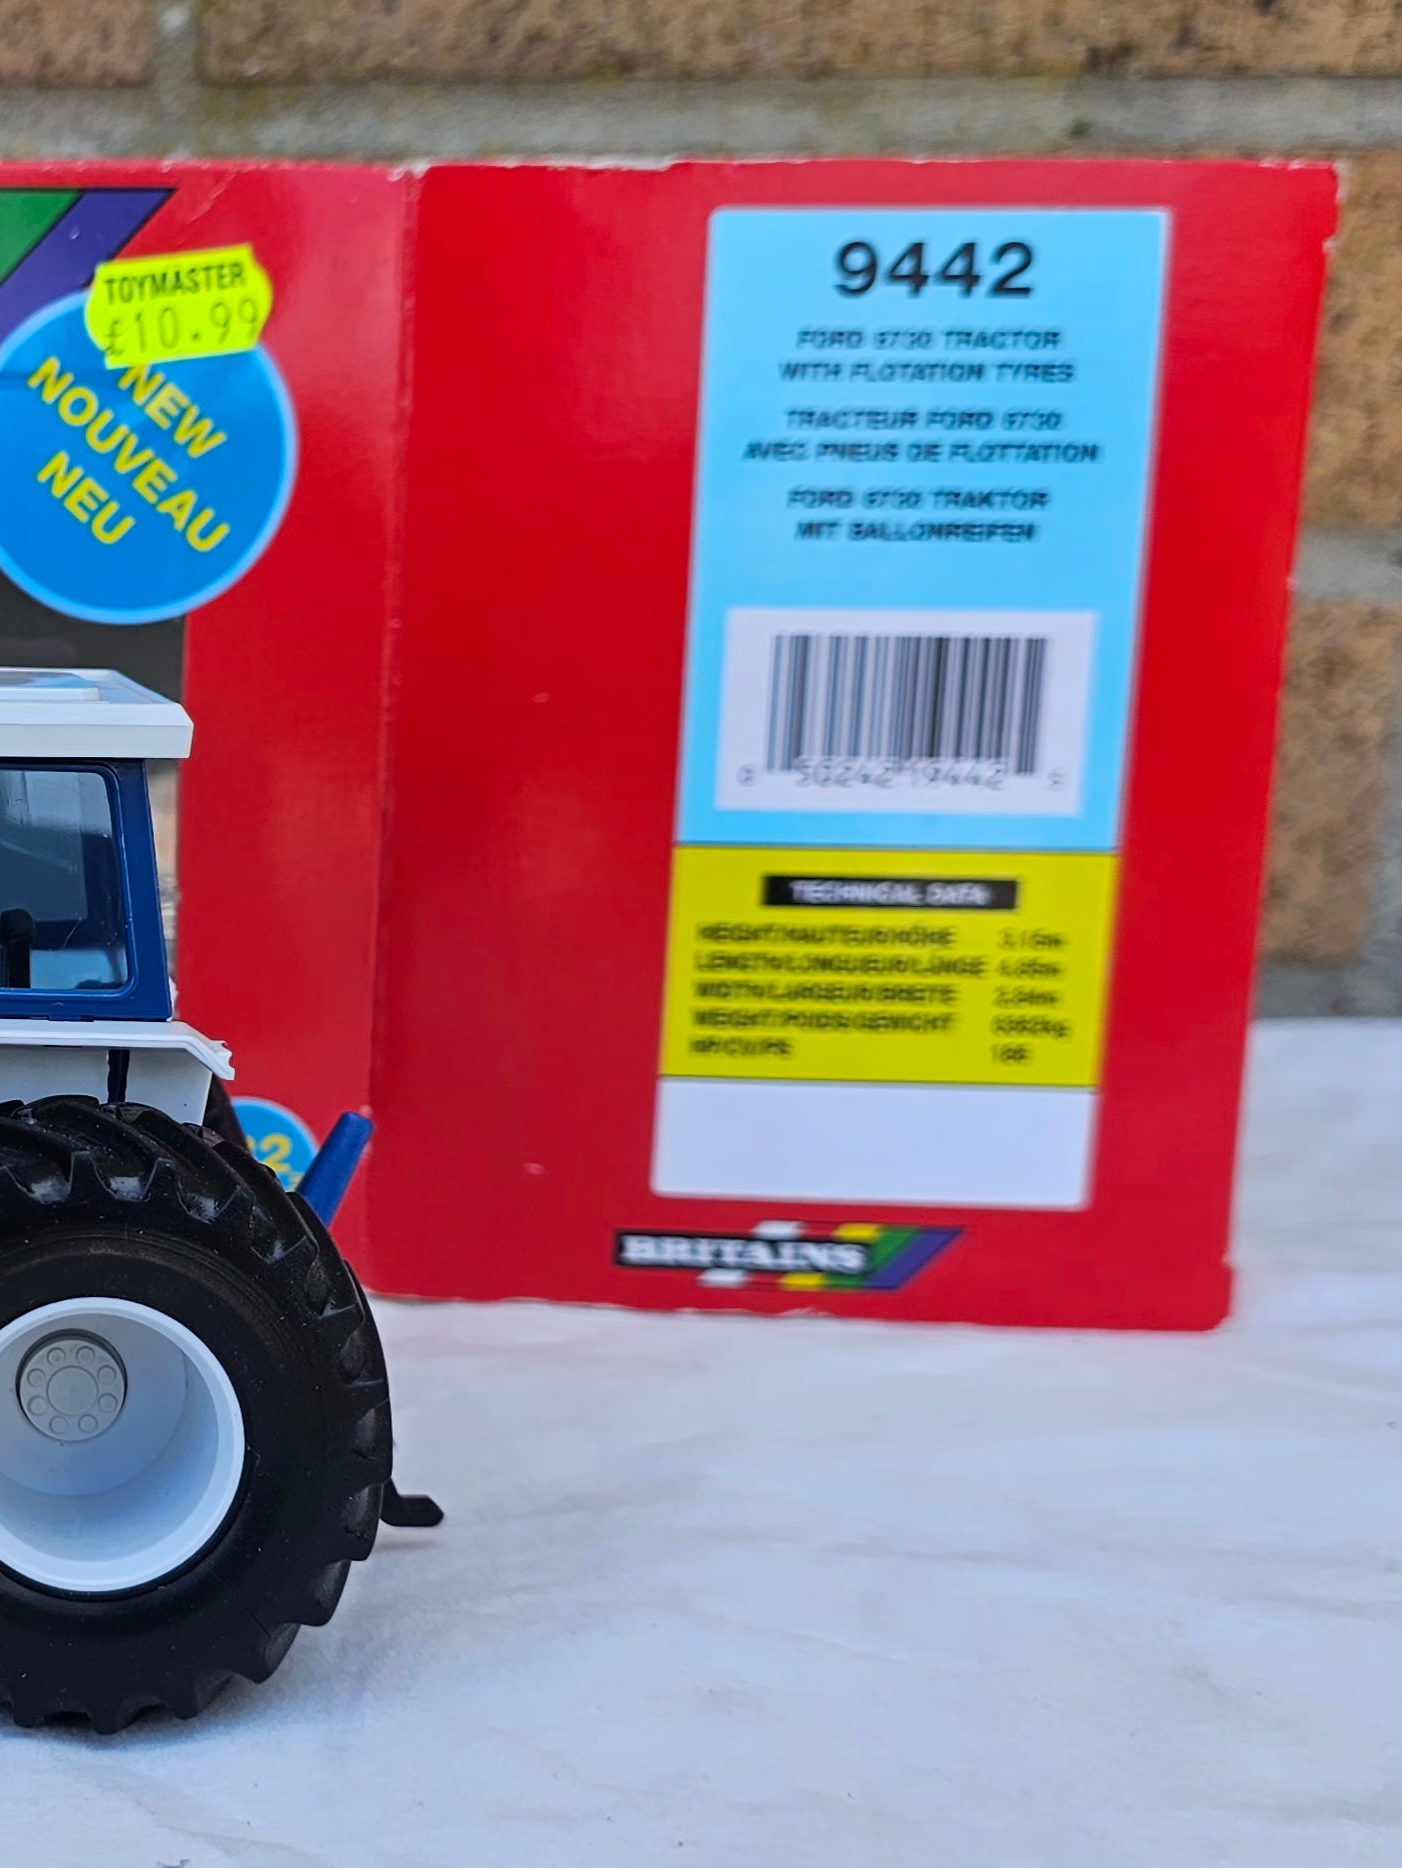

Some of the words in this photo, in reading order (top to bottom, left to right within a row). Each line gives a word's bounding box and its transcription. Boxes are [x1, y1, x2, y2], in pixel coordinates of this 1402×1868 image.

[104, 262, 246, 305] TOYMASTER
[834, 240, 1034, 299] 9442
[104, 298, 259, 357] £10.99
[797, 330, 864, 349] FORD
[945, 330, 1062, 349] TRACTOR
[780, 362, 842, 383] WITH
[849, 362, 985, 383] FLOTATION
[995, 362, 1074, 383] TYRES
[118, 362, 227, 458] NEW
[786, 410, 918, 430] TRACTEUR
[925, 410, 993, 430] FORD
[27, 356, 229, 552] NOUVEAU
[743, 442, 805, 463] AVEC
[816, 442, 898, 463] PNEUS
[906, 442, 941, 463] DE
[950, 442, 1100, 463] FLOTTATION
[36, 451, 135, 545] NEU
[787, 489, 853, 510] FORD
[932, 489, 1048, 510] TRAKTOR
[789, 880, 924, 904] TECHNICAL
[926, 882, 992, 905] DATA
[620, 1234, 868, 1273] BRITAINS
